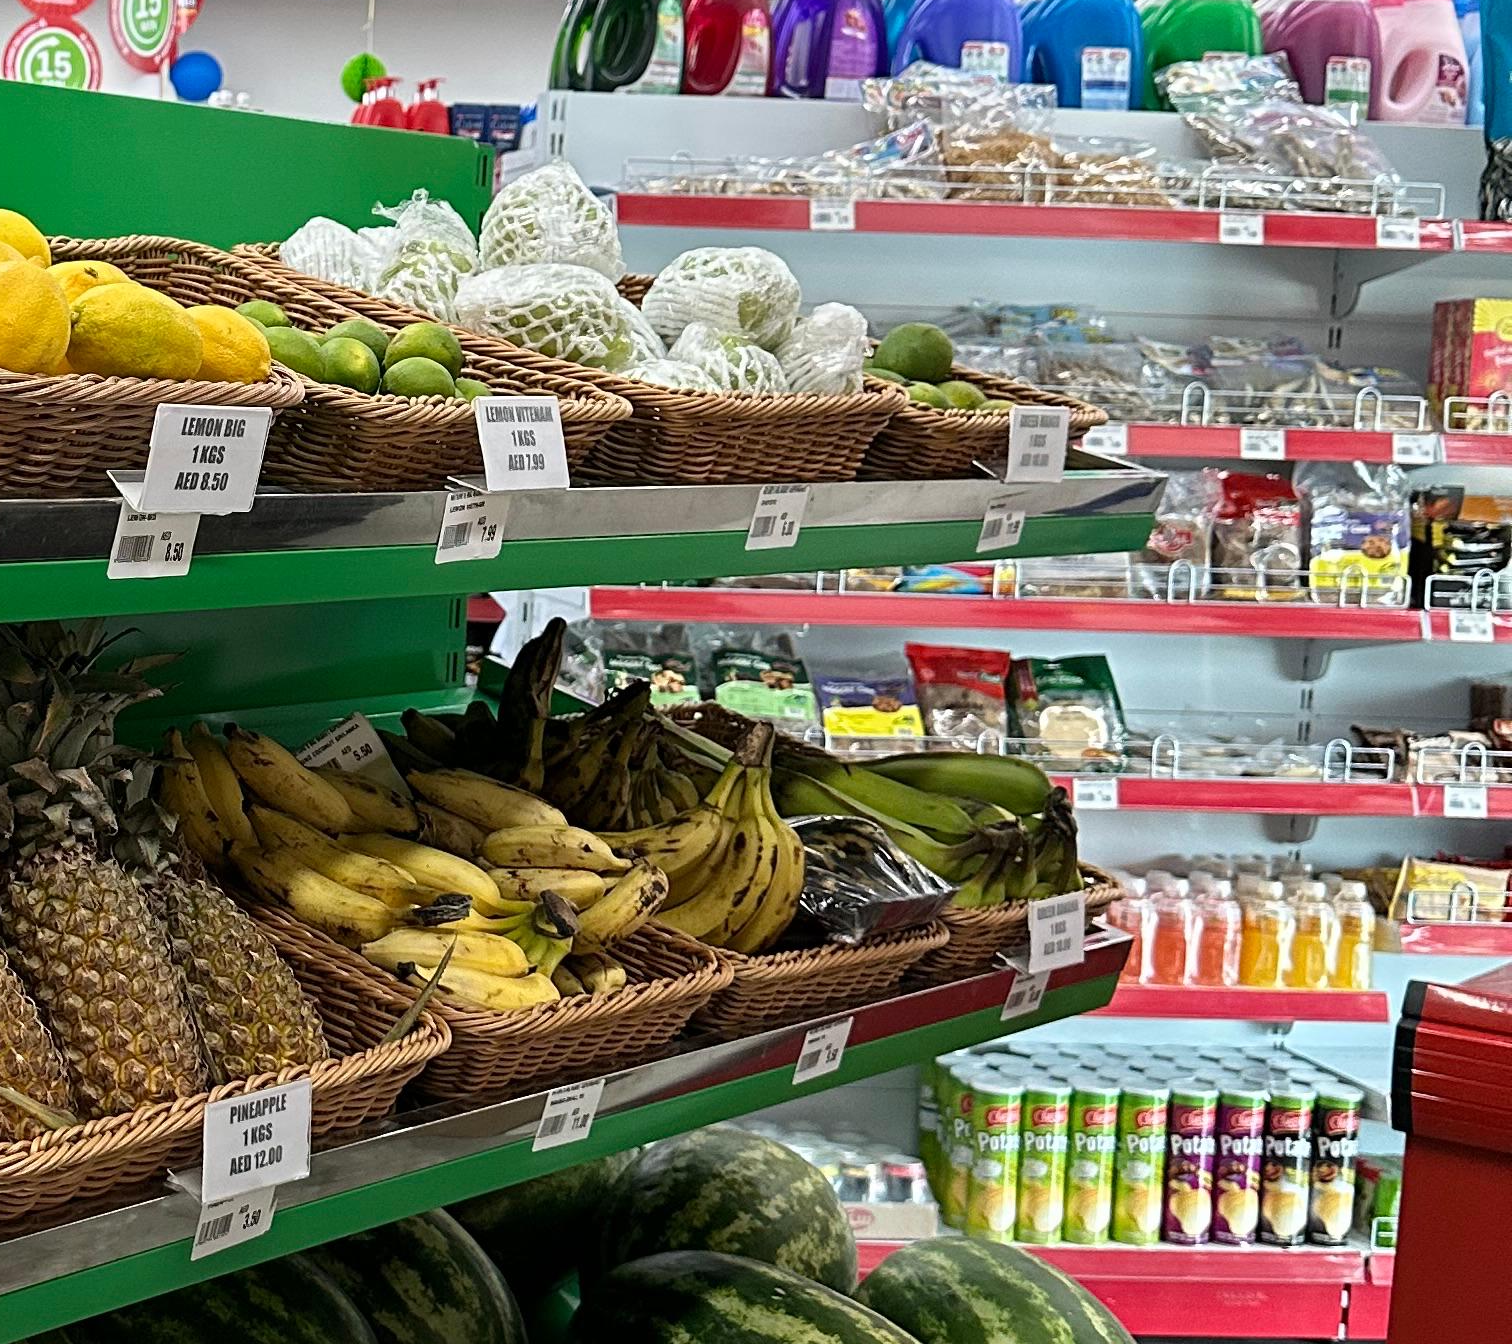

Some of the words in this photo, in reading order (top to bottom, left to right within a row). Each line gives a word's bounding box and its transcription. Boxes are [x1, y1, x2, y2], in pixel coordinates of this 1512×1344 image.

[37, 50, 72, 79] 15
[486, 406, 515, 422] LEMON
[181, 417, 223, 437] LEMON
[224, 419, 246, 438] BIG
[511, 432, 517, 446] 1
[518, 430, 536, 446] KGS
[192, 445, 199, 463] 1
[199, 445, 226, 464] KGS
[508, 455, 525, 471] AED
[526, 454, 545, 471] 7.99
[174, 472, 198, 490] AED
[199, 473, 229, 491] 8.50
[481, 524, 497, 542] 7.99
[165, 542, 185, 562] 8.50
[230, 1093, 287, 1124] PINEAPPLE
[242, 1130, 249, 1147] 1
[251, 1123, 273, 1144] KGS
[230, 1155, 252, 1176] AED
[254, 1145, 283, 1169] 12.00
[242, 1209, 262, 1230] 3.50
